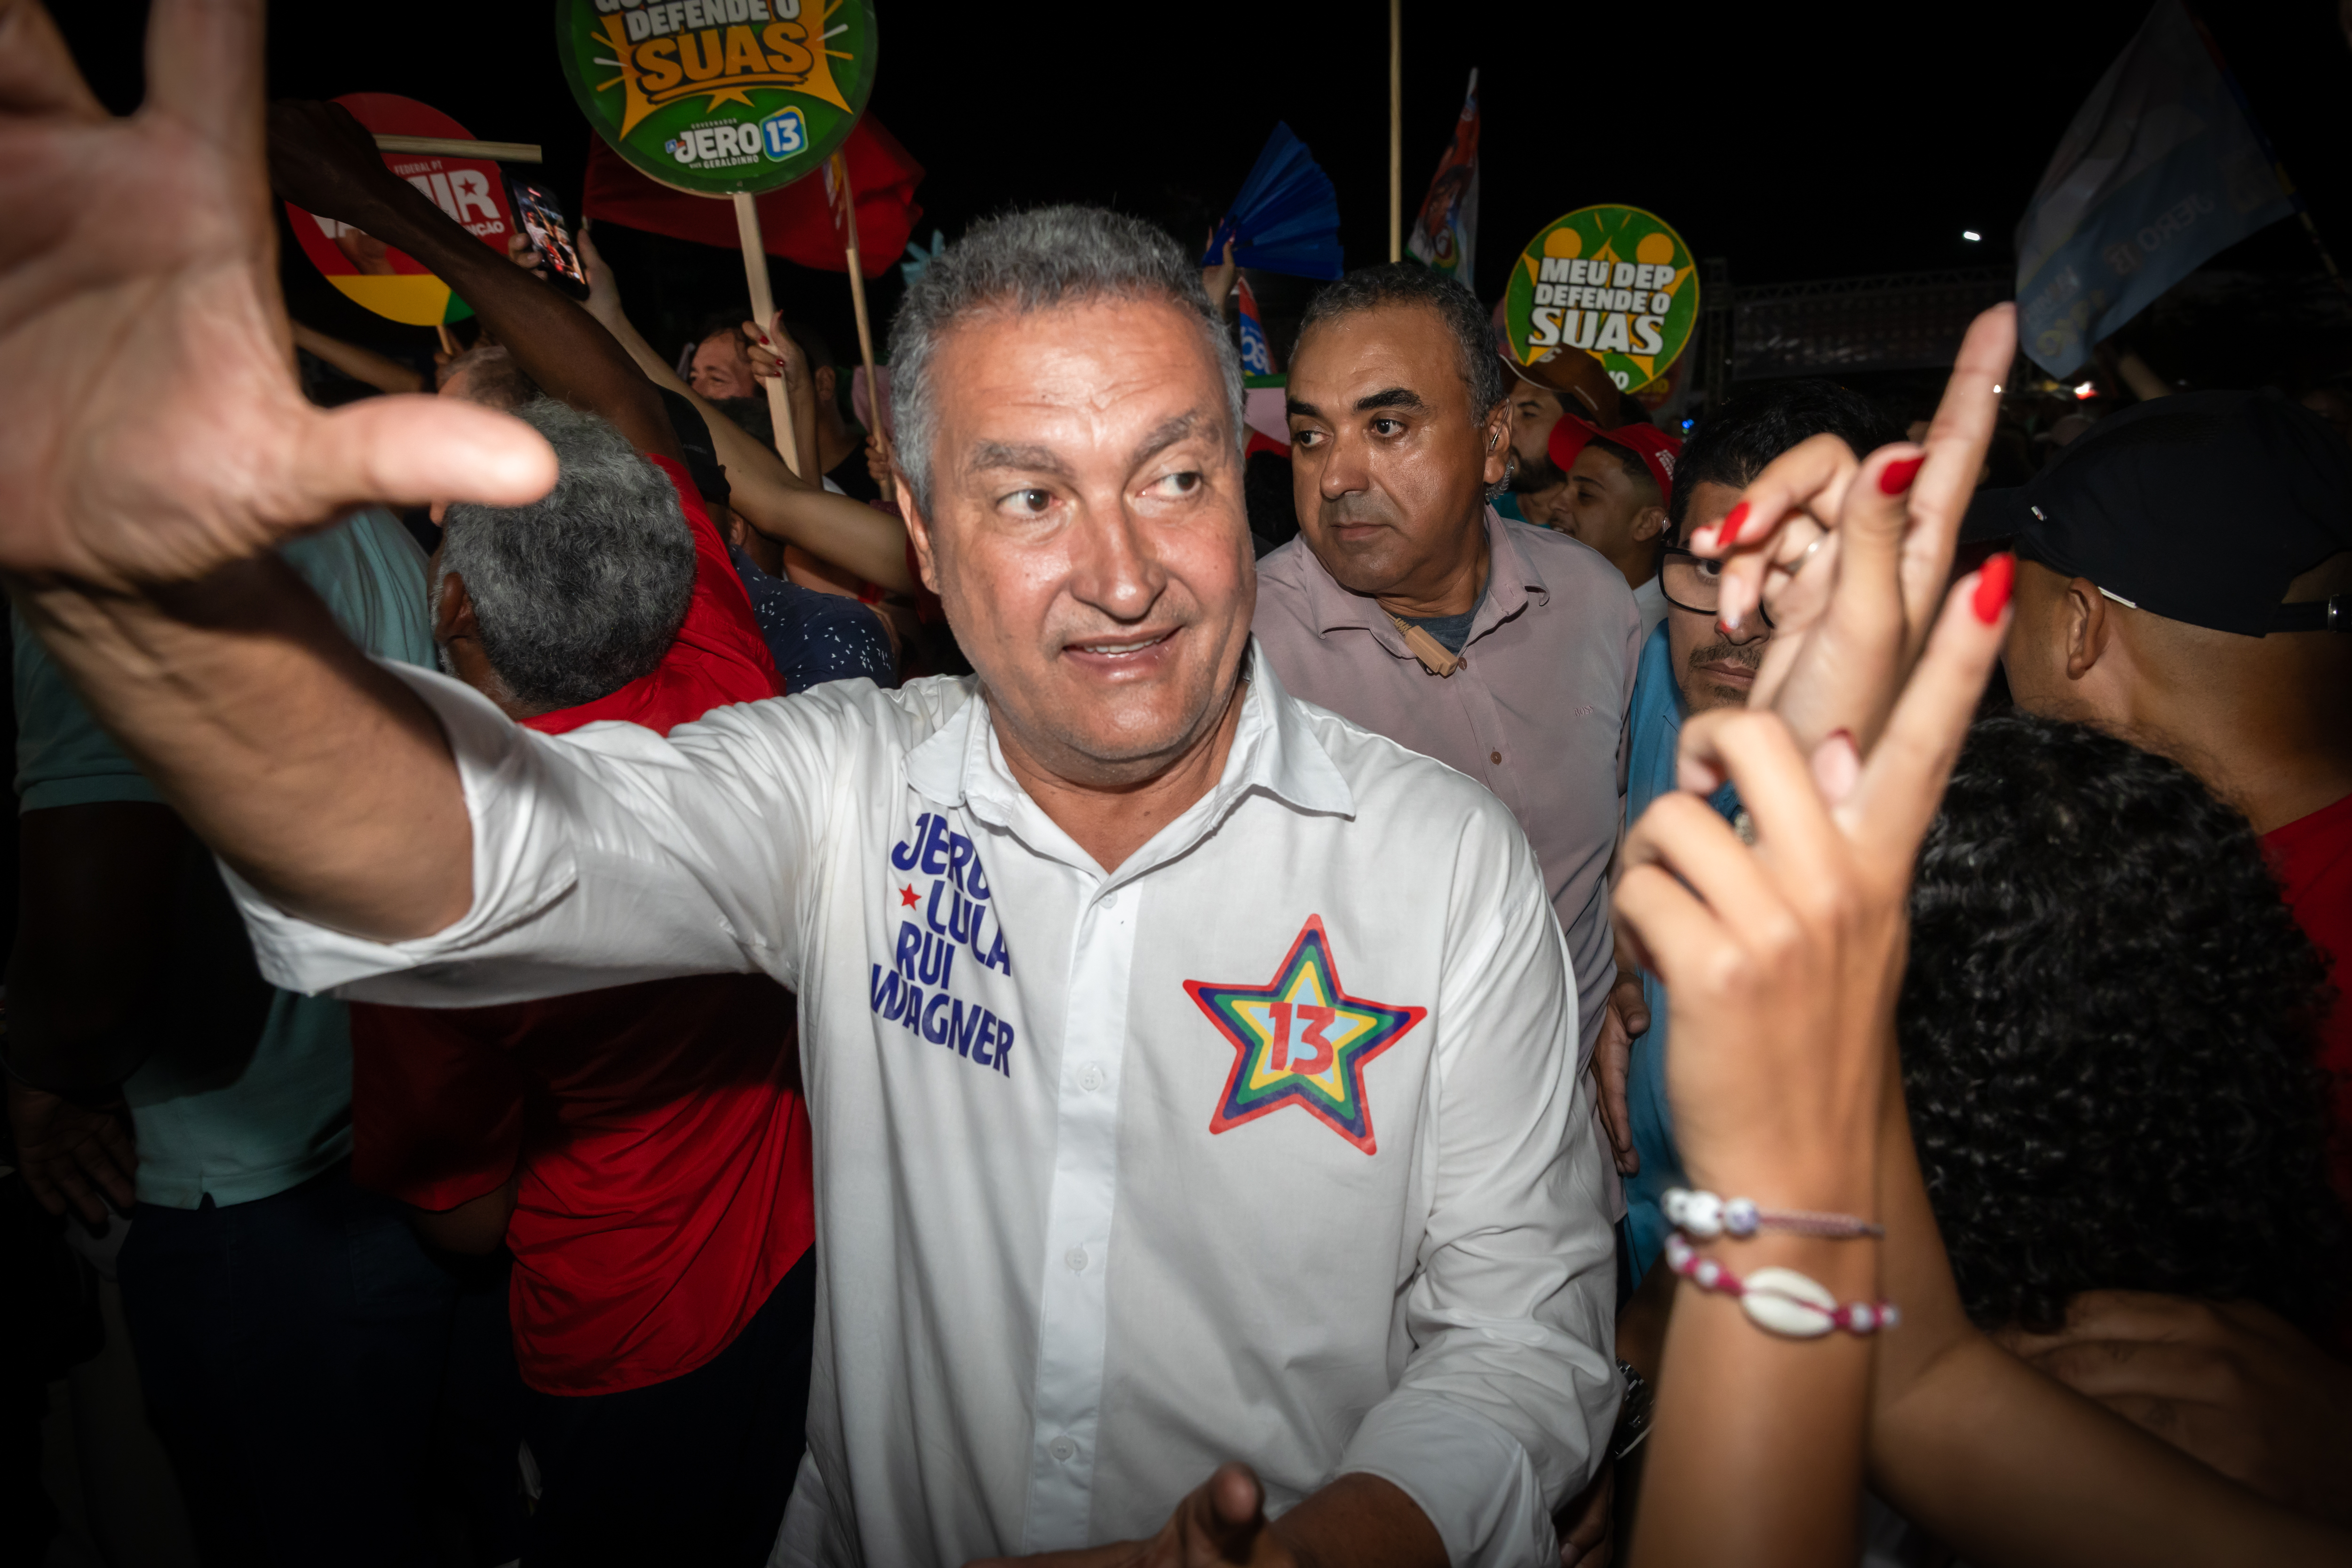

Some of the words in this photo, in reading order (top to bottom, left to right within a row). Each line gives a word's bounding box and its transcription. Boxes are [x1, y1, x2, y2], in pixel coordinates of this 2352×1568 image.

[625, 0, 771, 41] DEFENDE
[636, 22, 813, 91] SUAS
[674, 122, 762, 164] JERO
[765, 118, 801, 153] 13
[703, 154, 759, 169] GERALDINHO
[394, 162, 431, 175] FEDERAL
[430, 159, 443, 170] PT
[1539, 256, 1610, 286] MEU
[1612, 261, 1676, 290] DEP
[1534, 283, 1650, 313] DEFENDE
[1650, 292, 1671, 315] O
[1528, 306, 1665, 356] SUAS
[927, 879, 1011, 977] LULA
[896, 920, 956, 990] RUI
[870, 963, 1015, 1078] WAGNER
[1268, 1001, 1336, 1076] 13
